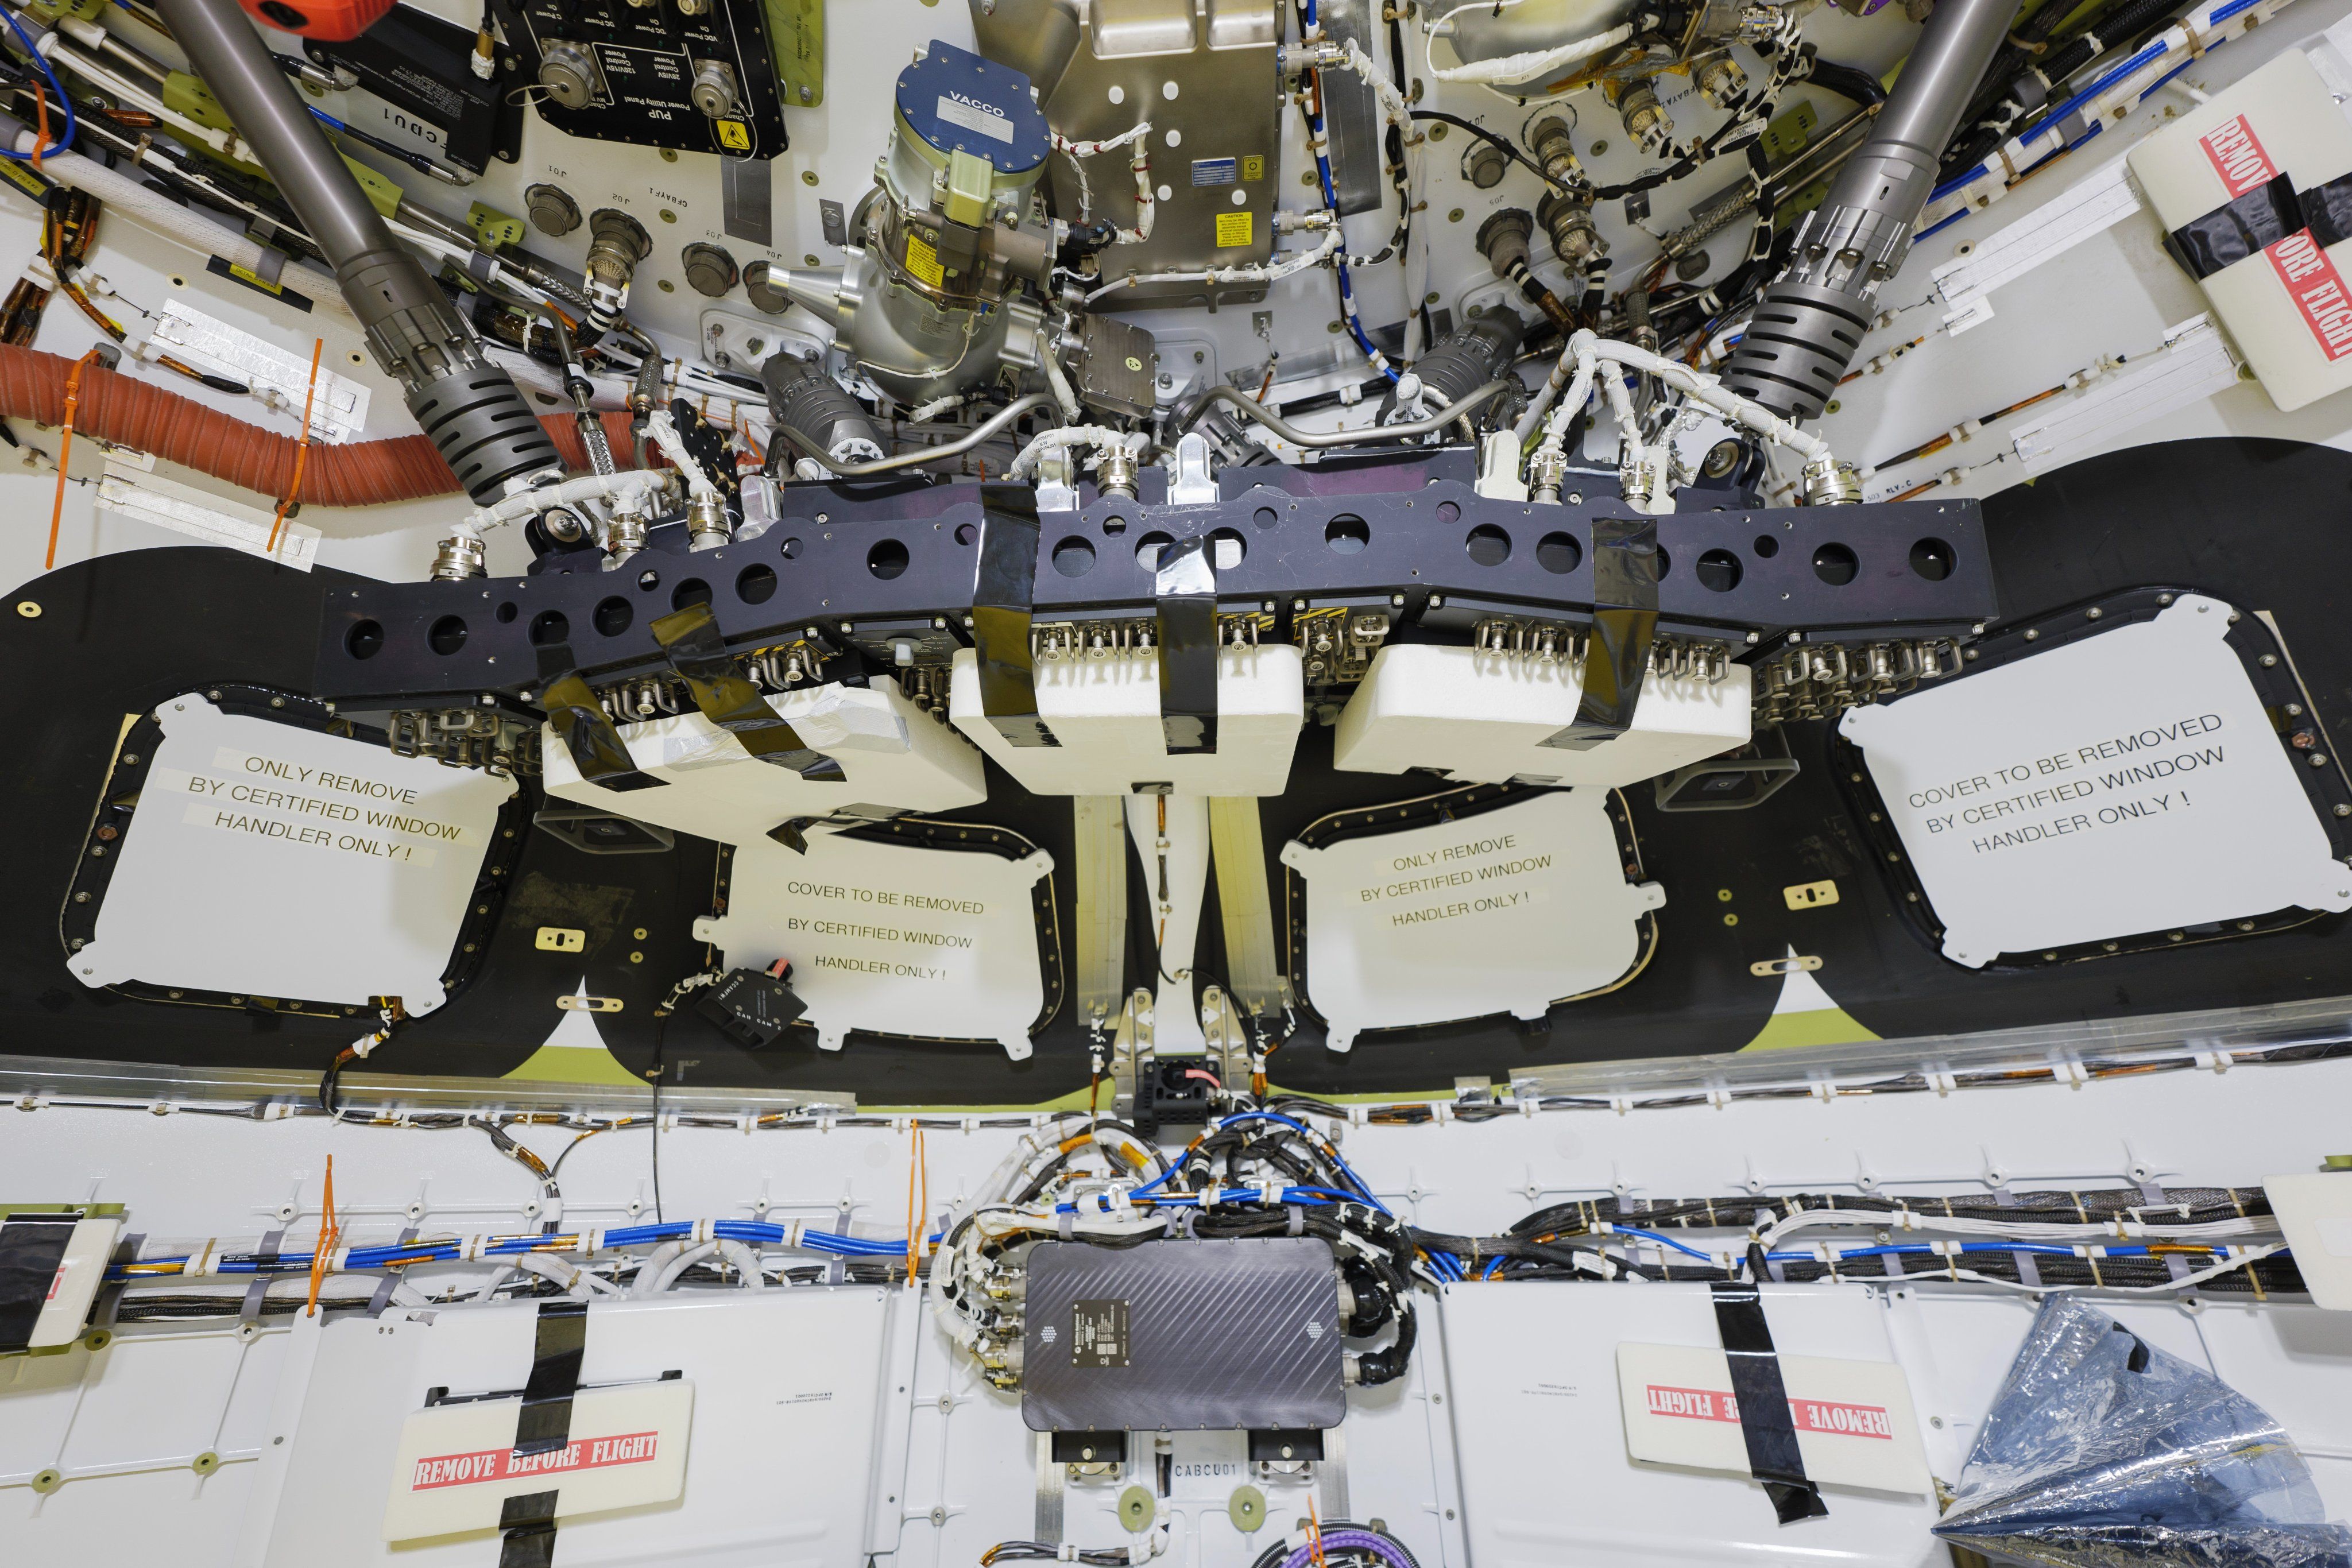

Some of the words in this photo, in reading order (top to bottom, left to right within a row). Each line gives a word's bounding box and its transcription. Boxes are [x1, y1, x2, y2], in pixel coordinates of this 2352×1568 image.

[584, 17, 605, 25] Power
[604, 49, 626, 58] Power
[605, 57, 631, 65] Control
[653, 56, 675, 64] Power
[653, 63, 679, 72] Control
[623, 95, 644, 104] Panel
[644, 98, 665, 107] Utility
[666, 101, 690, 110] Power
[948, 90, 1005, 117] VACCO
[1660, 85, 1696, 109] FBAYA1
[648, 109, 672, 120] PUP
[2205, 117, 2273, 196] REMOV
[547, 164, 567, 178] J01
[611, 193, 630, 205] J02
[647, 187, 688, 207] CFBAYF1
[1489, 195, 1505, 206] J05
[705, 229, 722, 239] J03
[765, 249, 782, 260] J04
[2270, 228, 2325, 285] ORE
[1909, 776, 1992, 808] COVER
[1994, 766, 2030, 786] TO
[2036, 753, 2072, 776] BE
[2078, 714, 2223, 764] REMOVED
[245, 756, 313, 783] ONLY
[319, 772, 417, 805] REMOVE
[1927, 814, 1955, 835] BY
[1964, 780, 2094, 826] CERTIFIED
[2099, 746, 2225, 790] WINDOW
[188, 776, 225, 797] BY
[231, 784, 359, 821] CERTIFIED
[367, 810, 461, 841] WINDOW
[1973, 815, 2092, 854] HANDLER
[2098, 794, 2171, 824] ONLY
[2183, 791, 2191, 806] !
[215, 811, 331, 846] HANDLER
[339, 835, 401, 858] ONLY
[404, 848, 411, 861] !
[1394, 849, 1440, 872] ONLY
[1444, 835, 1517, 861] REMOVE
[1361, 888, 1382, 903] BY
[1387, 870, 1473, 897] CERTIFIED
[1476, 854, 1552, 881] WINDOW
[788, 881, 845, 900] COVER
[852, 888, 875, 904] TO
[879, 891, 899, 907] BE
[904, 893, 984, 915] REMOVED
[1393, 902, 1469, 927] HANDLER
[1474, 895, 1521, 913] ONLY
[1525, 891, 1529, 904] !
[788, 917, 809, 932] BY
[814, 920, 900, 942] CERTIFIED
[903, 931, 973, 948] WINDOW
[815, 955, 891, 975] HANDLER
[895, 963, 937, 980] ONLY
[942, 969, 946, 981] !
[736, 1011, 751, 1020] CAB
[756, 1018, 772, 1027] CAM
[1649, 1389, 1714, 1418] FLIGHT
[1809, 1404, 1891, 1437] REMOVE
[414, 1455, 496, 1486] REMOVE
[506, 1443, 581, 1475] BEFORE
[592, 1434, 657, 1463] FLIGHT
[1175, 1464, 1237, 1477] CABCU01
